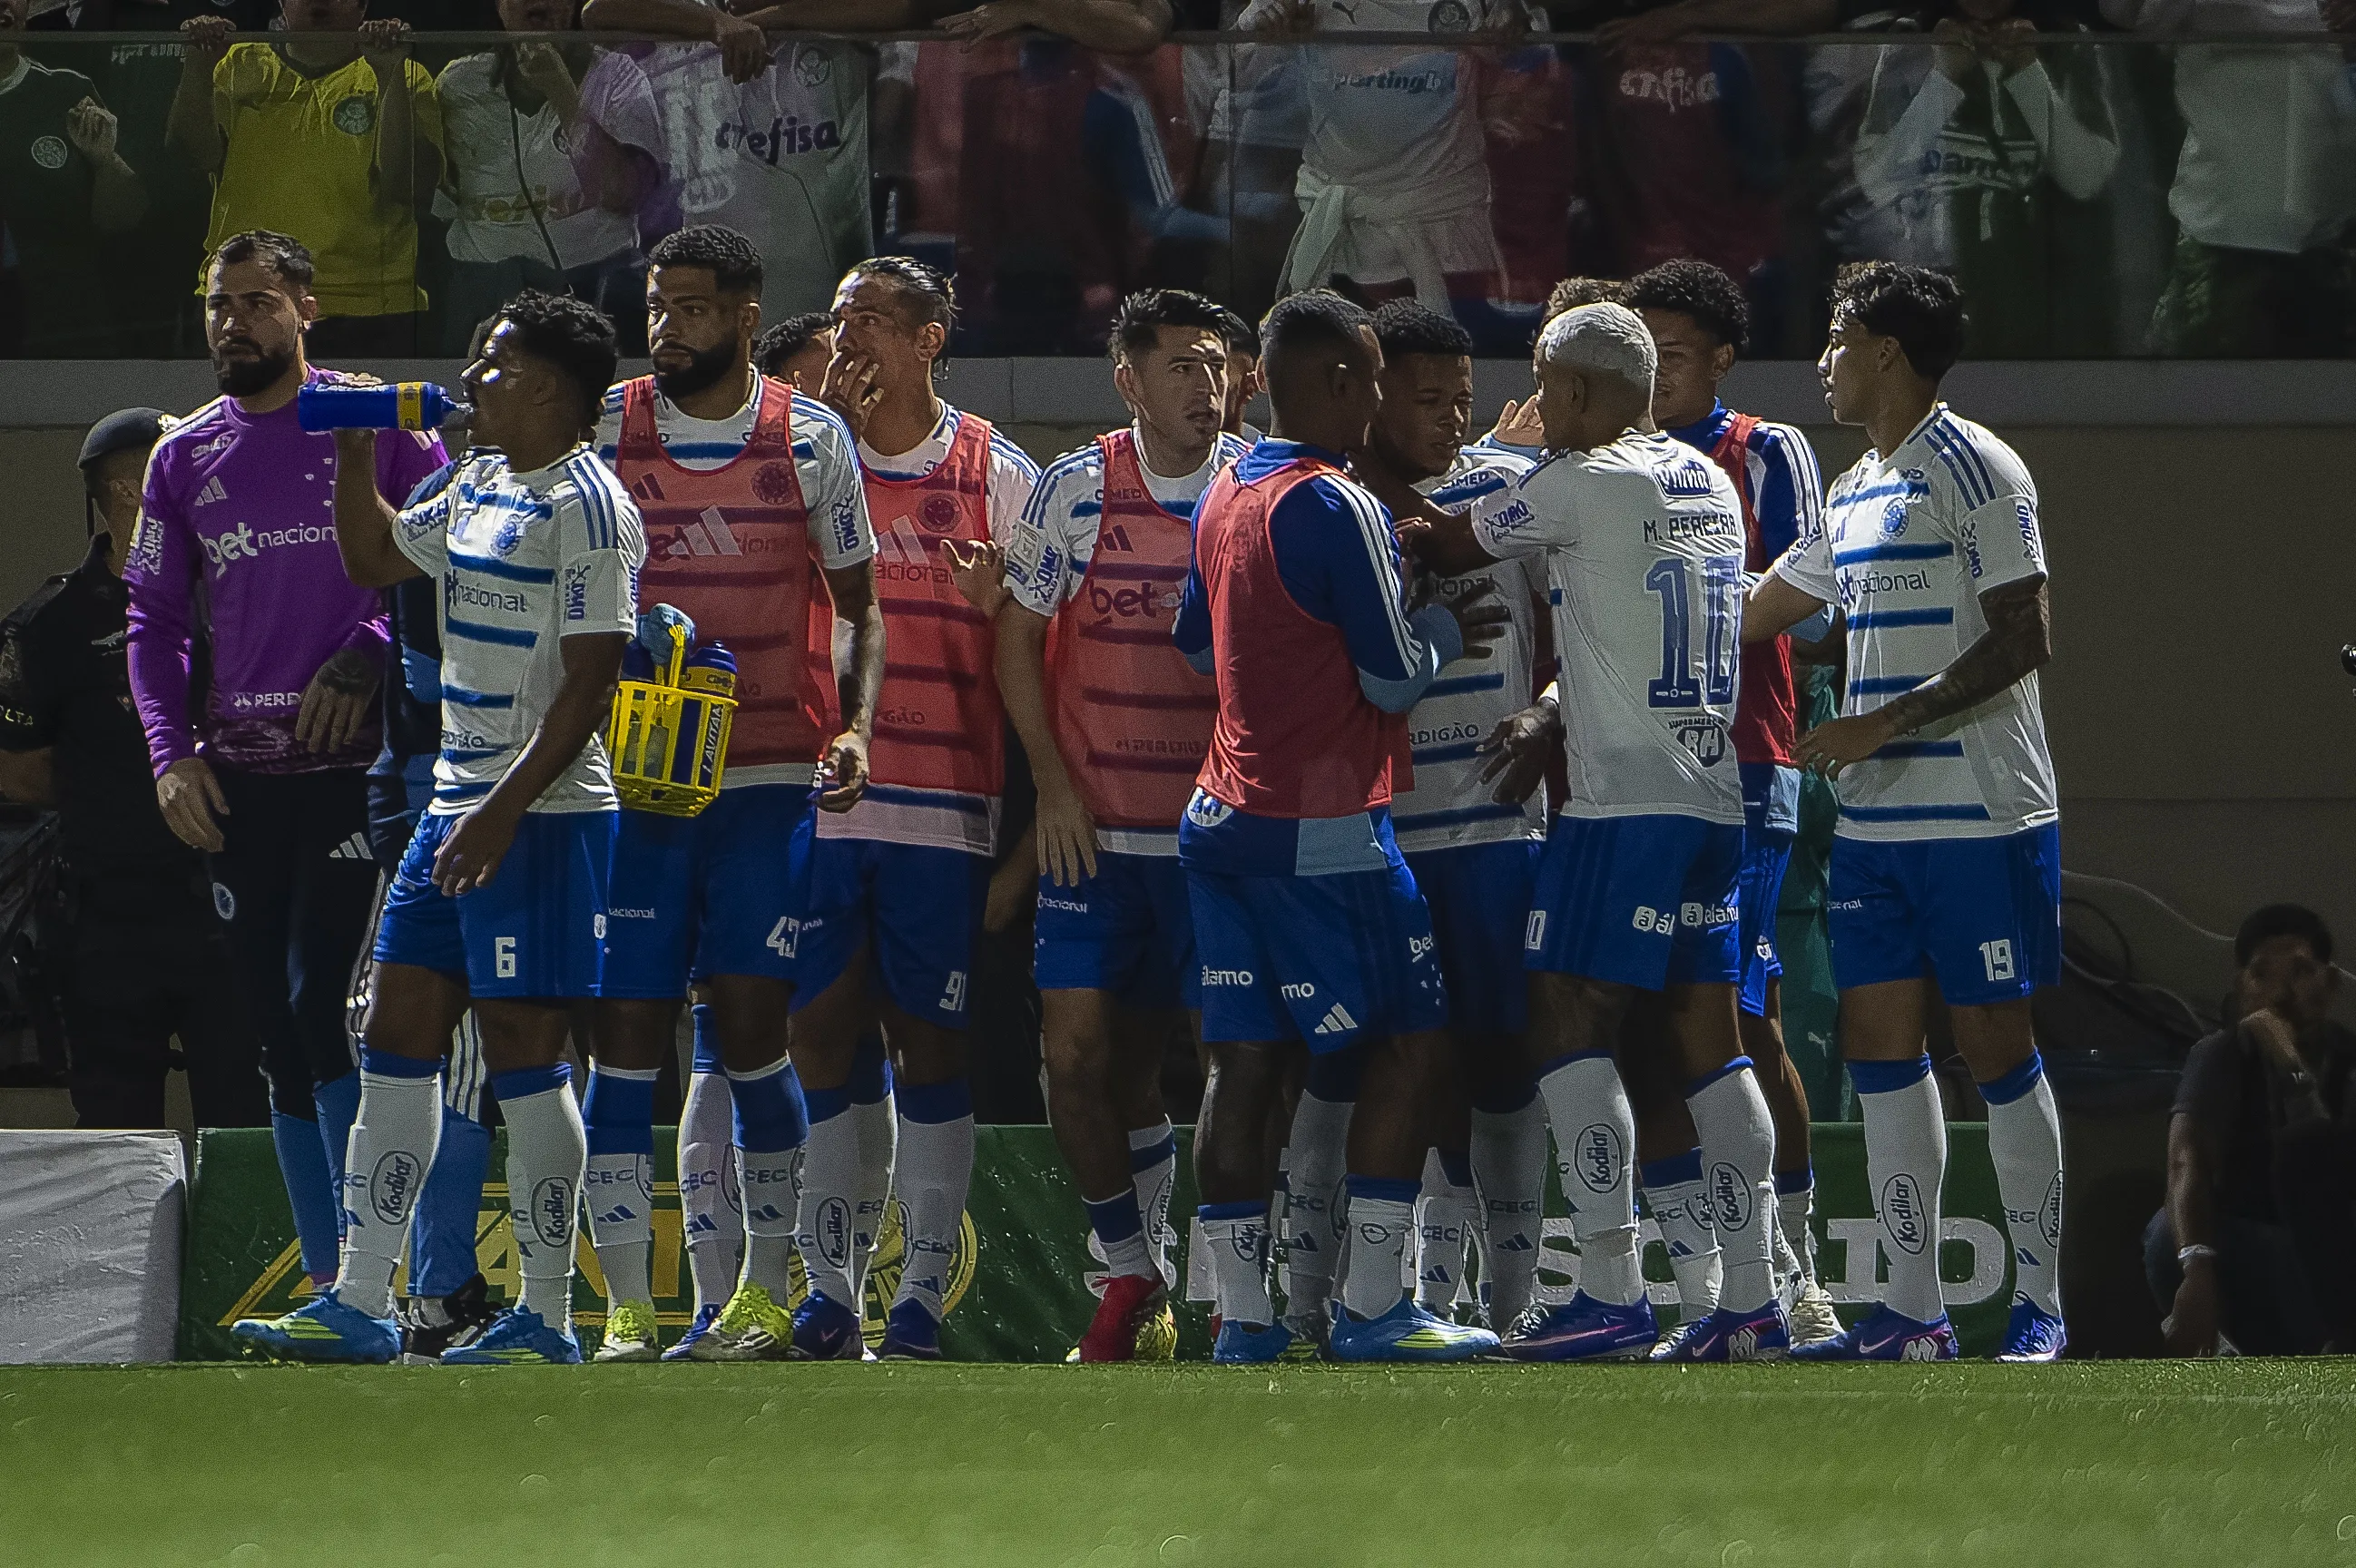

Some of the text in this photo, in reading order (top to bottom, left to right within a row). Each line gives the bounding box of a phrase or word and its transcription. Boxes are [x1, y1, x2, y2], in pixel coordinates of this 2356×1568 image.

[197, 522, 337, 579] bet nacion
[1644, 556, 1742, 708] 10
[495, 936, 517, 978] 6
[1978, 938, 2016, 983] 19
[1586, 1129, 1612, 1185] Kodilar
[379, 1154, 413, 1218] Kodilar
[545, 1182, 567, 1240] Kodilar
[1890, 1179, 1920, 1244] Kodilar
[2007, 1210, 2037, 1223] EC
